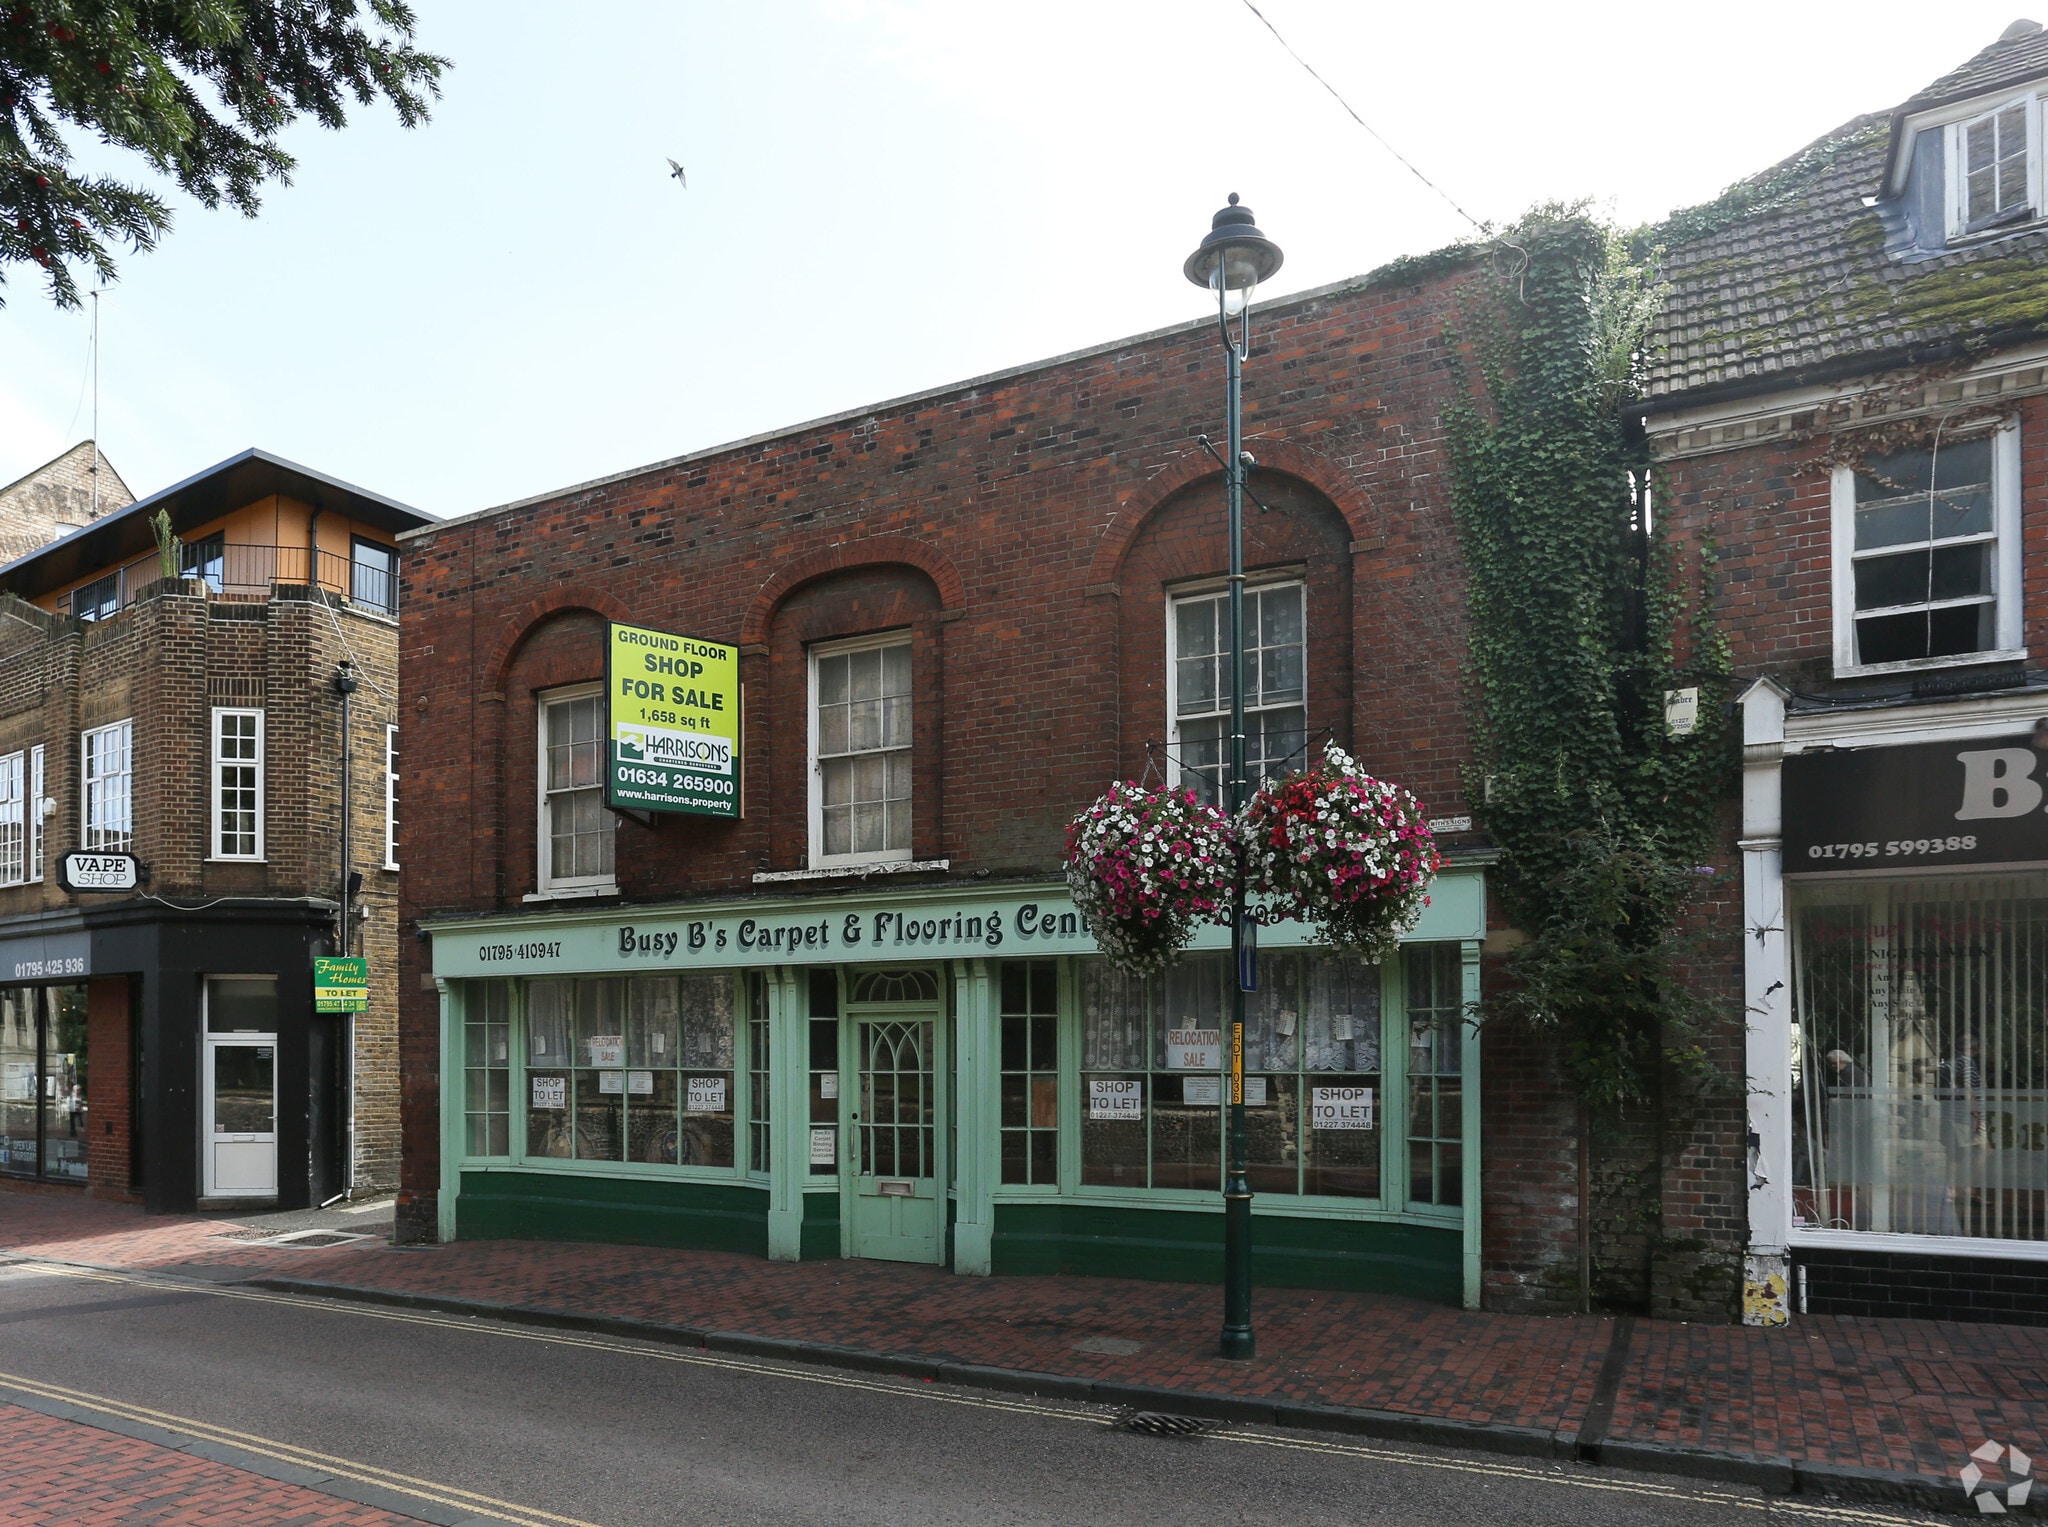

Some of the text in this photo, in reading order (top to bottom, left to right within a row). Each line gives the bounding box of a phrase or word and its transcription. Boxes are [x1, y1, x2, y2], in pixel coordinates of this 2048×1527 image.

[618, 630, 727, 661] GROUND FLOOR
[644, 653, 704, 679] SHOP
[622, 677, 724, 711] FOR SALE
[640, 708, 710, 730] 1,658 sq ft
[645, 734, 729, 763] HARRISONS
[617, 766, 734, 795] 01634 265900
[1955, 747, 2048, 821] B
[617, 788, 731, 811] www.harrisons.property
[1808, 835, 1977, 859] 01795 599388
[74, 857, 127, 873] VAPE
[78, 872, 127, 886] SHOP
[619, 903, 1092, 957] Busy B's Carpet & Flooring Cent
[15, 957, 84, 977] 01795 425 936
[315, 959, 359, 975] Family
[329, 972, 366, 984] Homes
[1169, 1030, 1220, 1046] RELOCATION
[1233, 1024, 1241, 1063] EHDT
[600, 1051, 615, 1061] SALE
[1183, 1052, 1205, 1067] SALE
[536, 1078, 561, 1088] SHOP
[691, 1079, 720, 1088] SHOP
[1096, 1081, 1134, 1093] SHOP
[533, 1091, 564, 1101] TO LET
[689, 1092, 724, 1102] TO LET
[1320, 1088, 1364, 1101] SHOP
[1091, 1097, 1139, 1109] TO LET
[1314, 1105, 1370, 1118] TO LET
[1341, 1121, 1371, 1129] 374448
